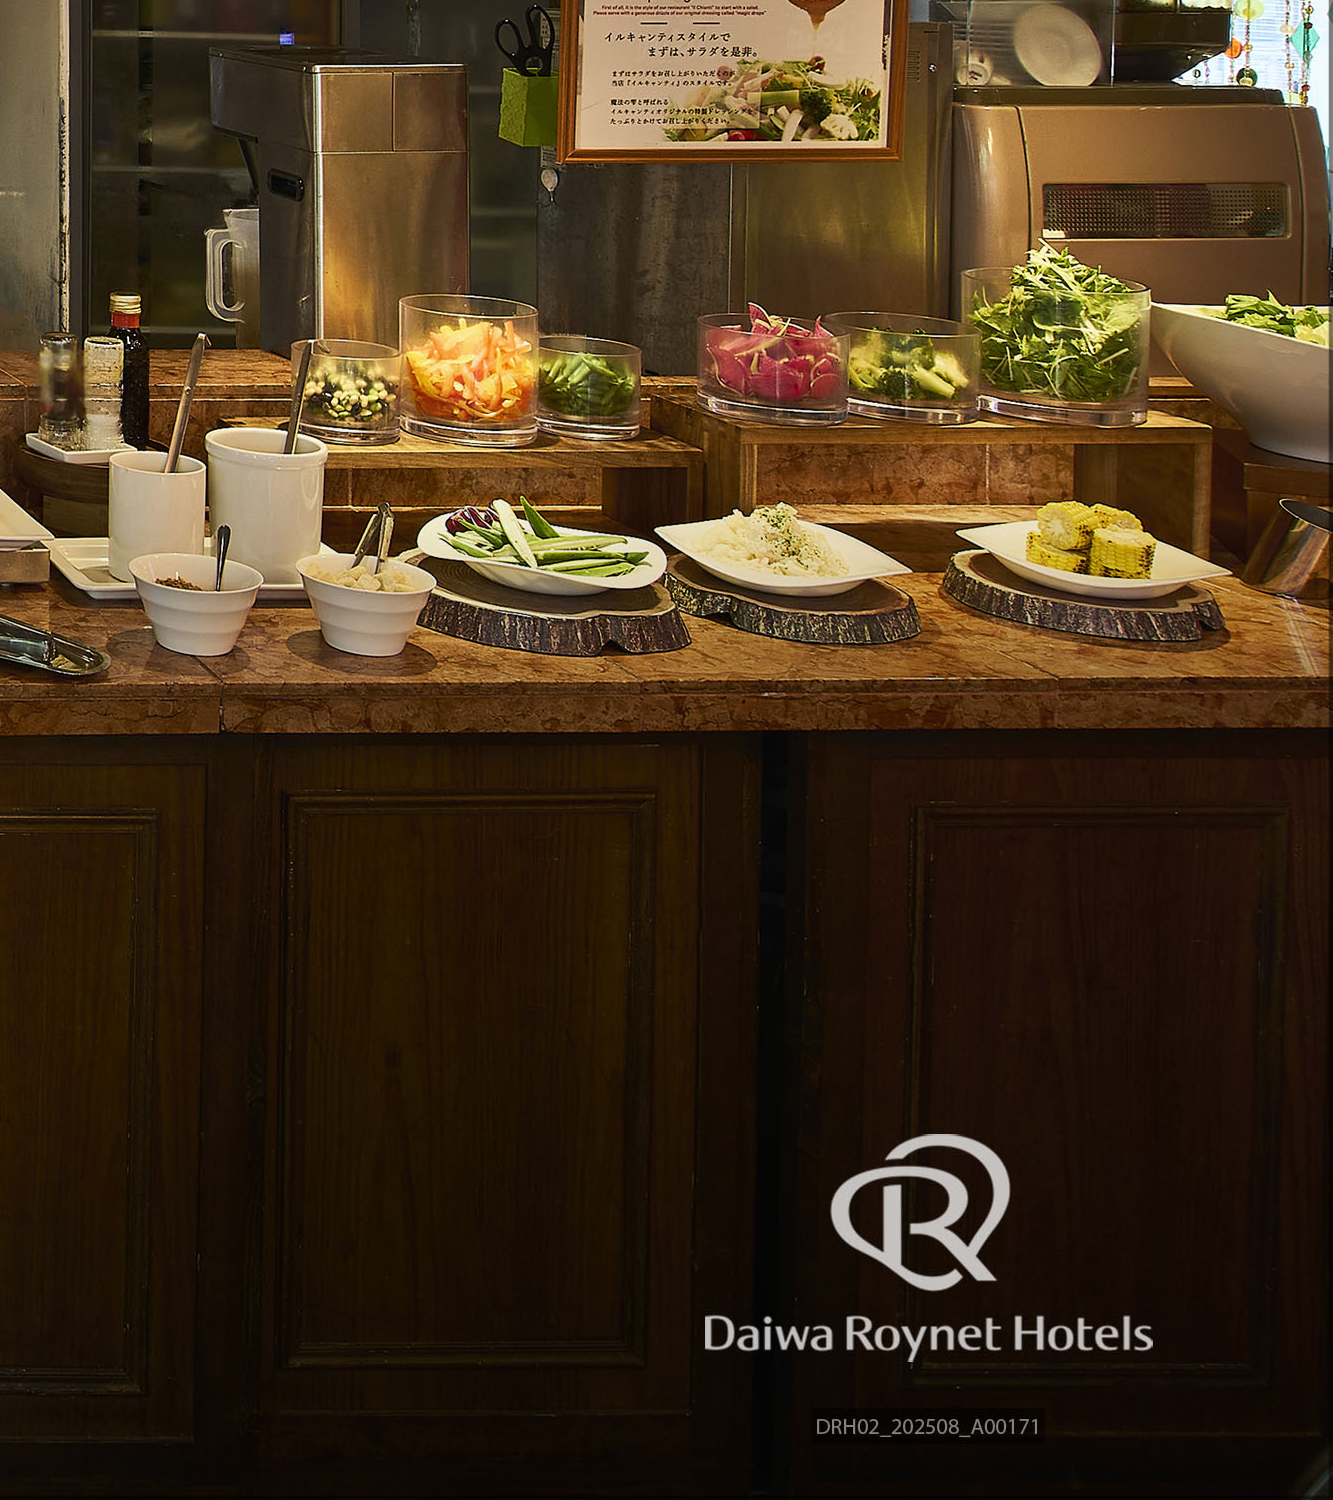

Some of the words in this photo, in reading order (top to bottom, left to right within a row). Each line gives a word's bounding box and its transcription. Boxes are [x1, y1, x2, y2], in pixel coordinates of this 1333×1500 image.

[604, 32, 731, 43] イルキャンティスタイルで
[648, 46, 758, 58] まずは、サラダを是非。
